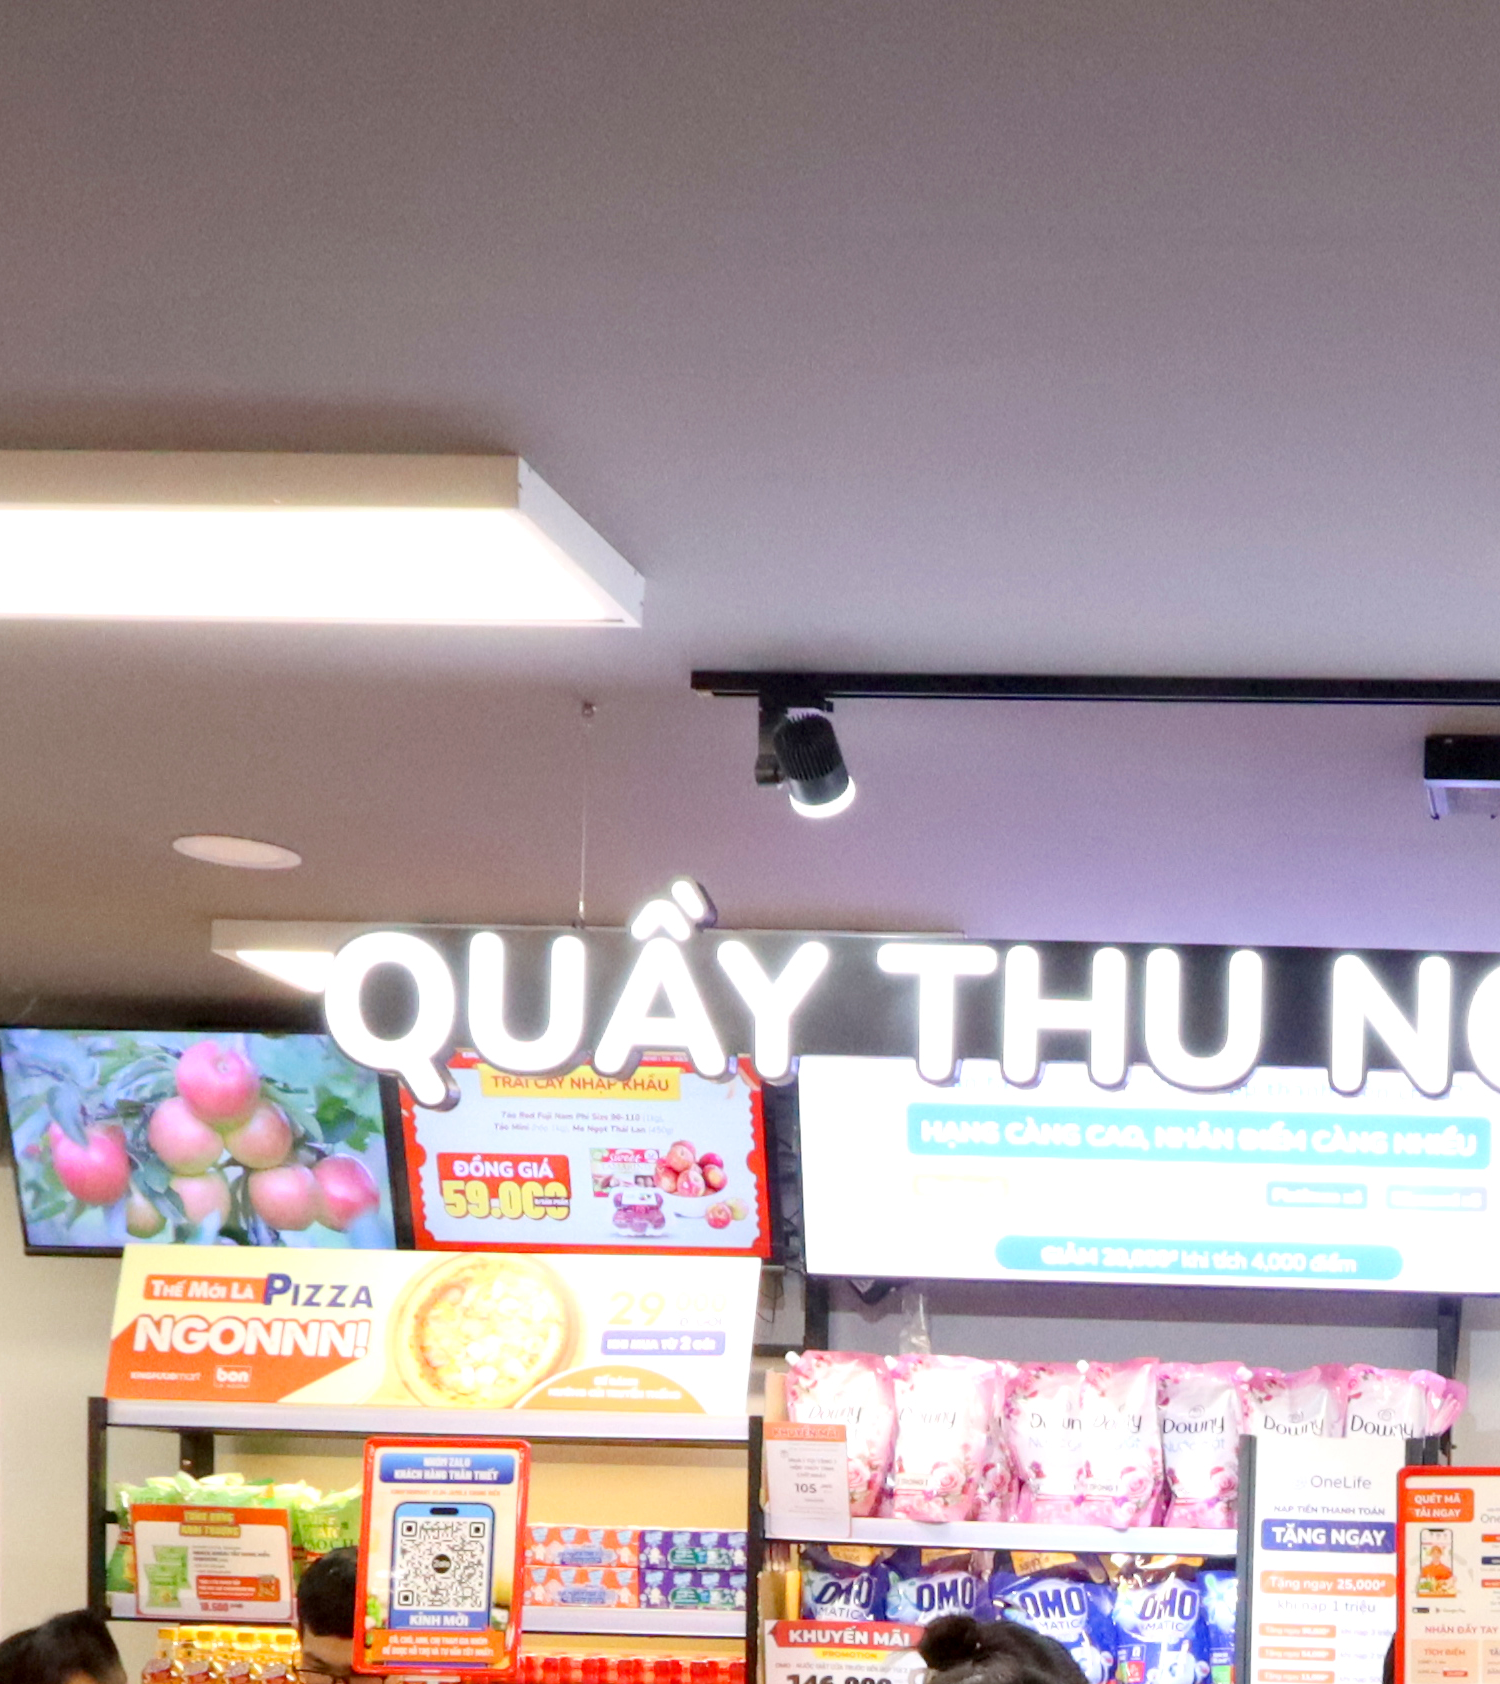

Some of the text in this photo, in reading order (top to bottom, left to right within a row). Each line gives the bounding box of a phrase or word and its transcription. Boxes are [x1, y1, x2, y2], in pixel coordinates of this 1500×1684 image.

[322, 879, 829, 1111] QUẦY
[876, 941, 1268, 1094] THU
[921, 1117, 1000, 1149] HẠNG
[1005, 1117, 1082, 1147] CÀNG
[1311, 1123, 1389, 1156] CÀNG
[453, 1153, 554, 1179] ĐỒNG GIÁ
[1182, 1248, 1209, 1270] khi
[133, 1314, 372, 1358] NGONNN!
[1159, 1414, 1226, 1435] Downy
[793, 1482, 818, 1494] 105
[1310, 1475, 1372, 1490] OneLife
[1444, 1493, 1461, 1504] MÃ
[1431, 1508, 1462, 1519] NGAY
[1272, 1522, 1386, 1548] TẶNG NGAY
[915, 1577, 976, 1613] OMO
[1303, 1579, 1333, 1592] ngay
[1020, 1587, 1085, 1621] OMO
[1141, 1587, 1198, 1620] OMO
[1332, 1600, 1339, 1612] 1
[788, 1625, 911, 1647] KHUYẾN MÃI
